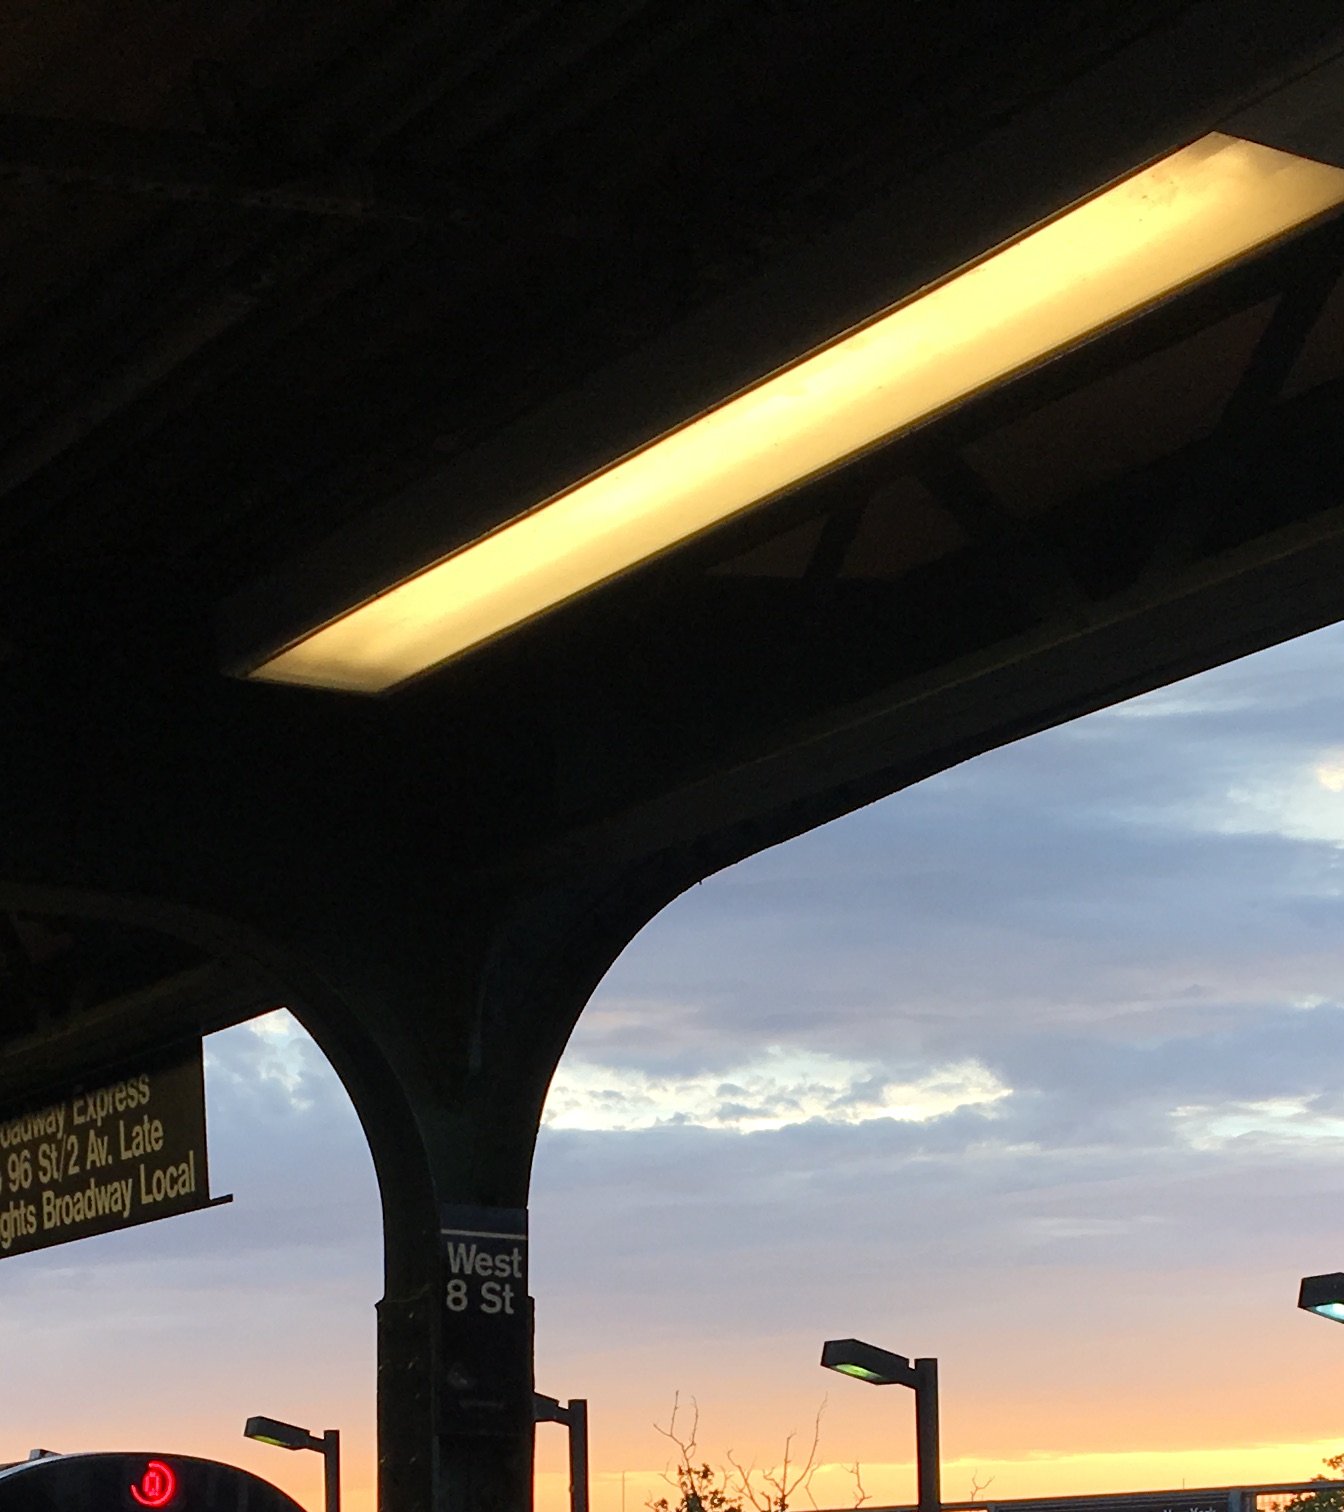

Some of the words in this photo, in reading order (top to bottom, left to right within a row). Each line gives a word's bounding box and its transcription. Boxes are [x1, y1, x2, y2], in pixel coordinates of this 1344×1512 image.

[72, 1073, 151, 1127] Express
[8, 1149, 32, 1192] 96
[86, 1129, 113, 1169] Av.
[118, 1114, 164, 1160] Late
[42, 1177, 133, 1230] Broadway
[139, 1149, 196, 1205] Local
[446, 1241, 523, 1279] West
[446, 1278, 469, 1312] 8
[480, 1281, 515, 1315] St
